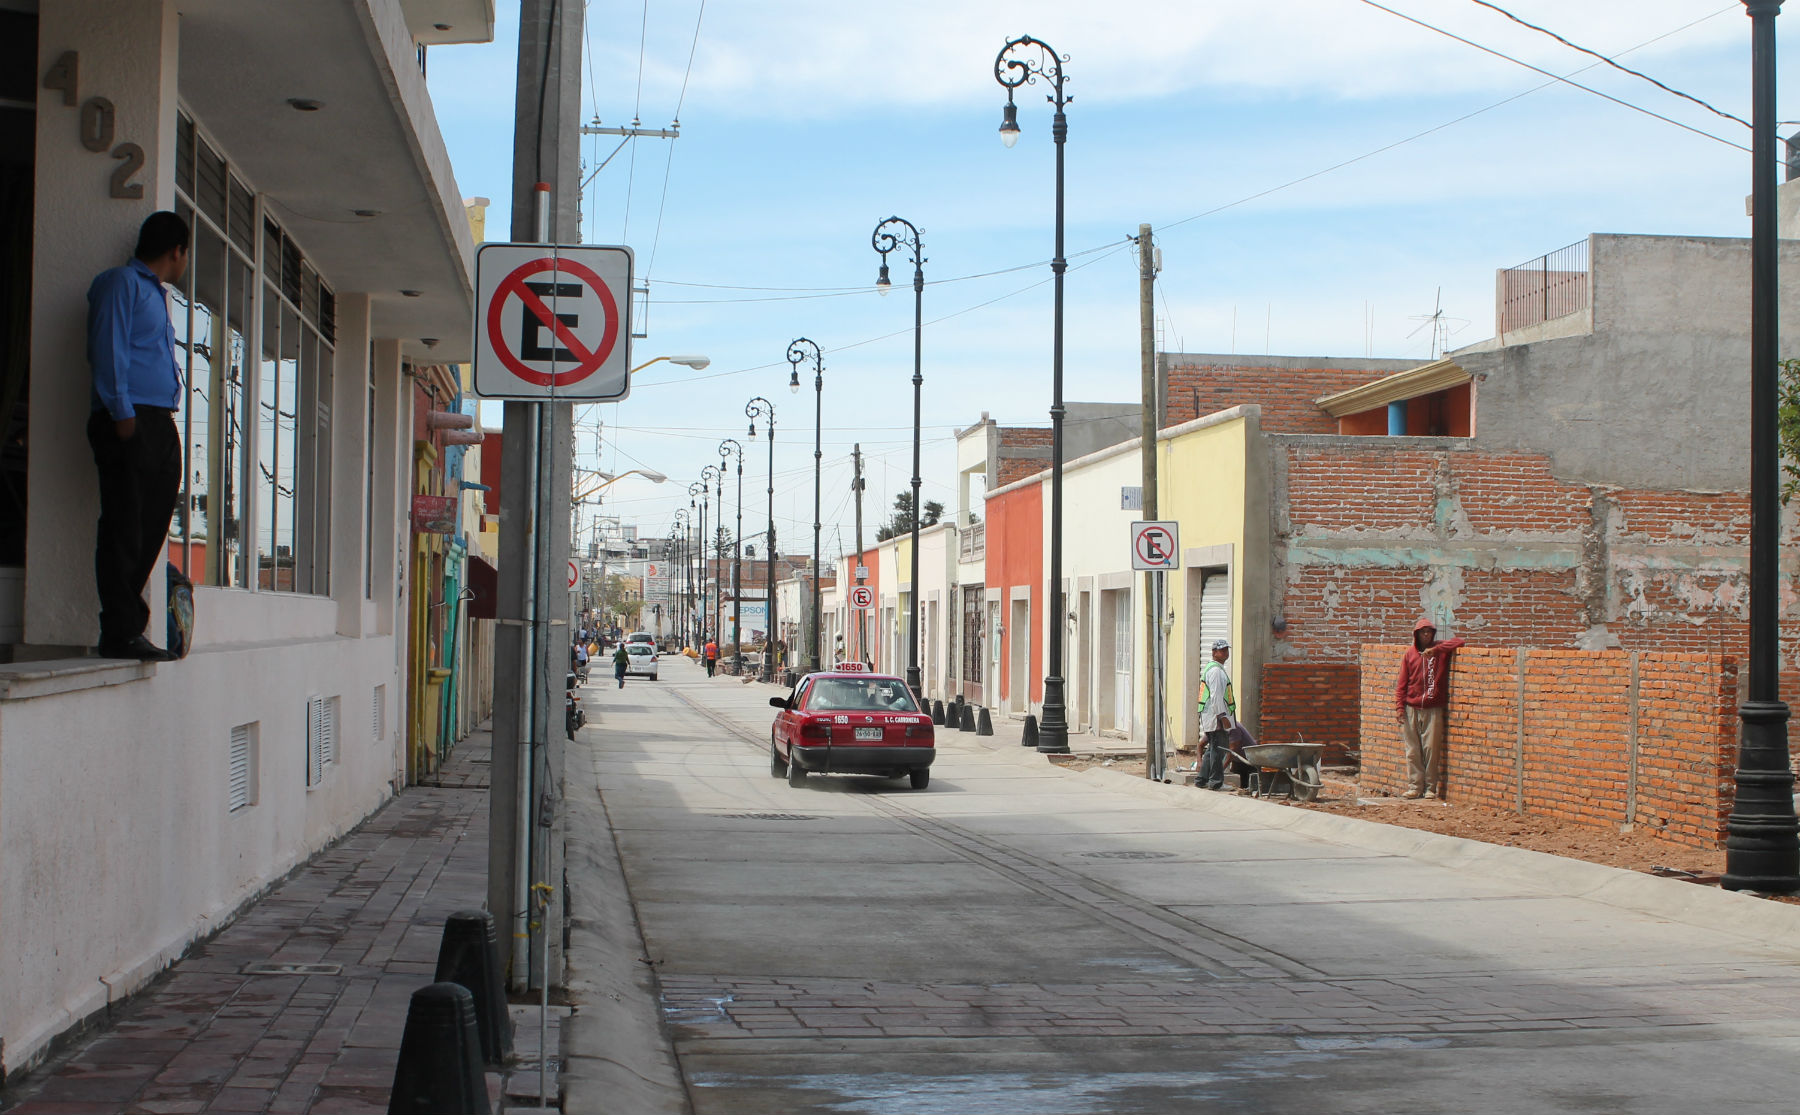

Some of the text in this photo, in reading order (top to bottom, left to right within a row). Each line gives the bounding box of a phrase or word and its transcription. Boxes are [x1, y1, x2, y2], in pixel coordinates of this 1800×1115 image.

[43, 50, 145, 200] 402
[521, 281, 584, 362] E
[1147, 532, 1163, 559] E
[858, 591, 868, 603] E
[841, 663, 862, 671] 1650
[834, 715, 848, 724] 1650
